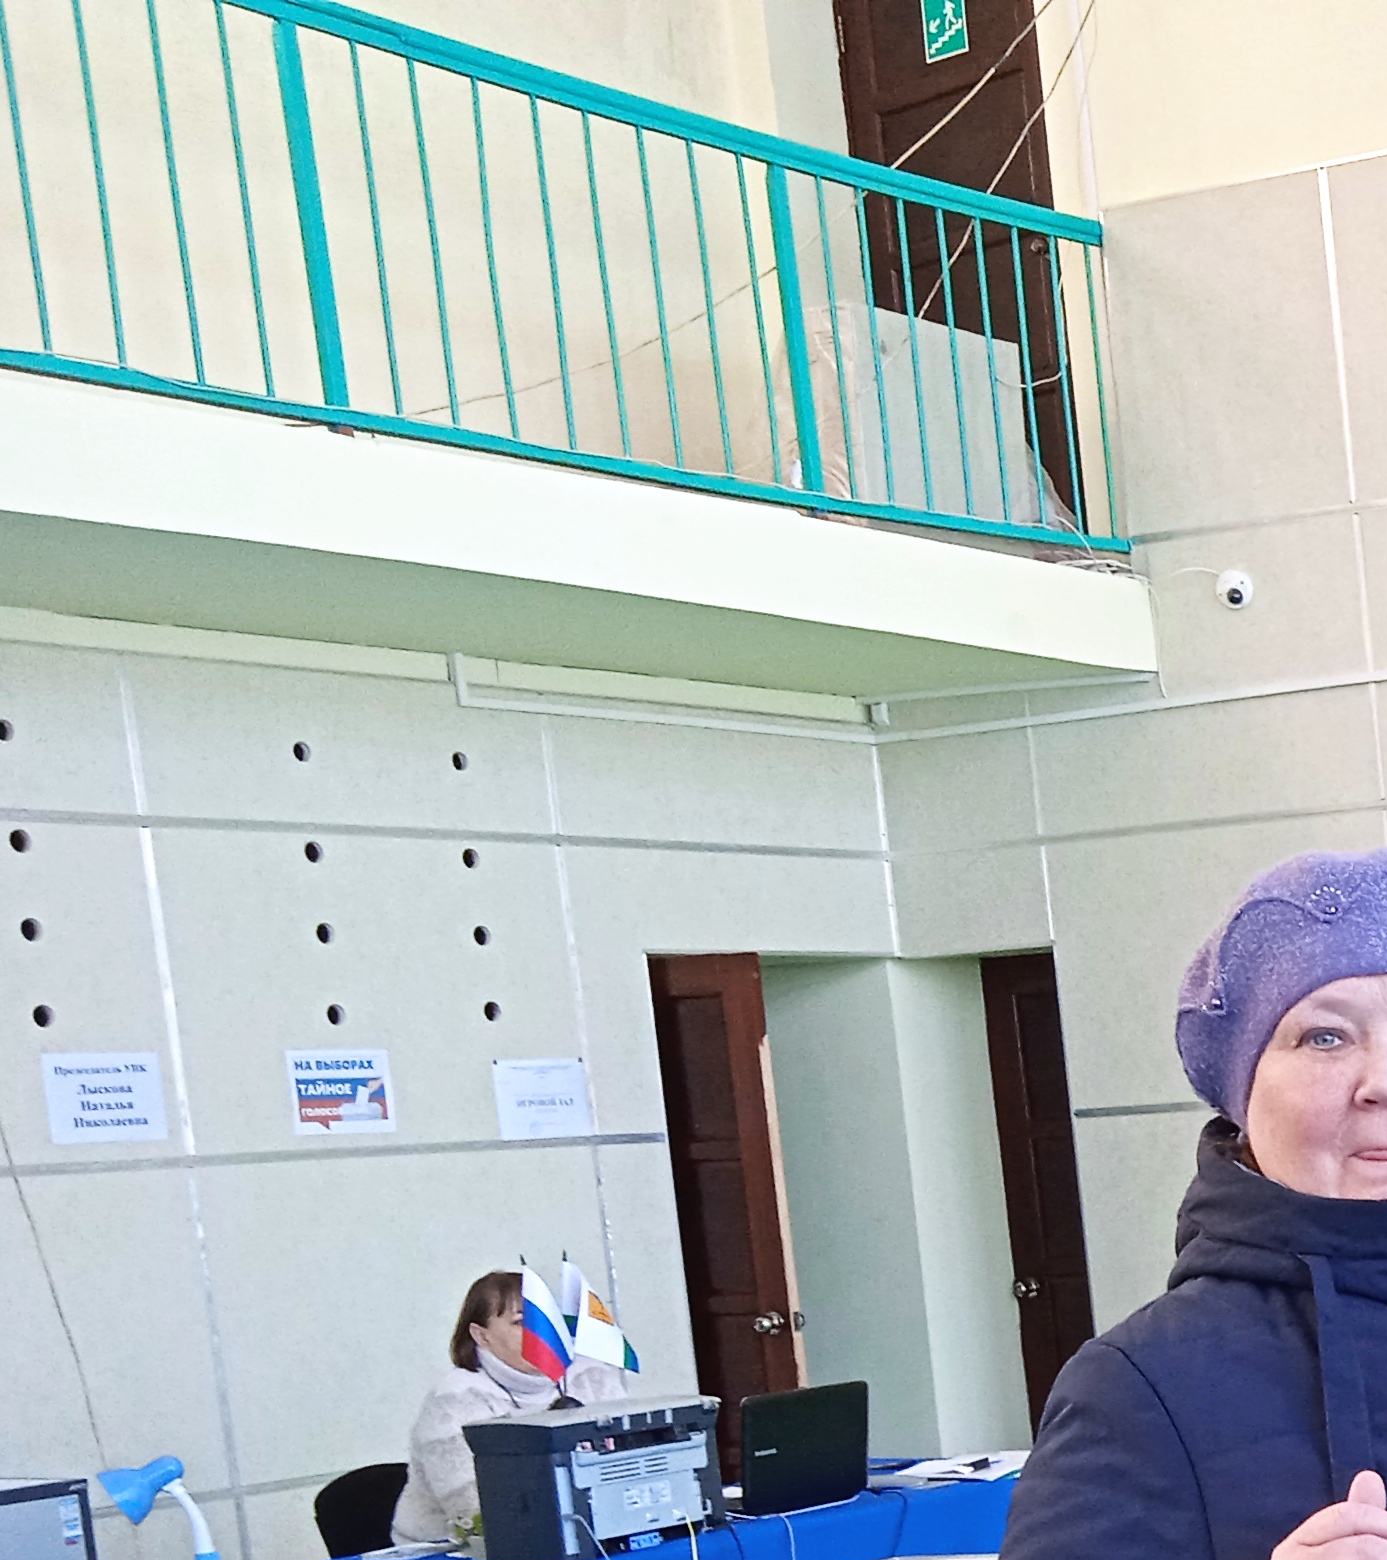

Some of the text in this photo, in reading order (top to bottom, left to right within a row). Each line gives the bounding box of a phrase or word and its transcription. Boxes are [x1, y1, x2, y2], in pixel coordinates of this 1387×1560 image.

[294, 1059, 374, 1071] НА ВЫБОРАХ
[297, 1081, 353, 1096] ТАЙНОЕ
